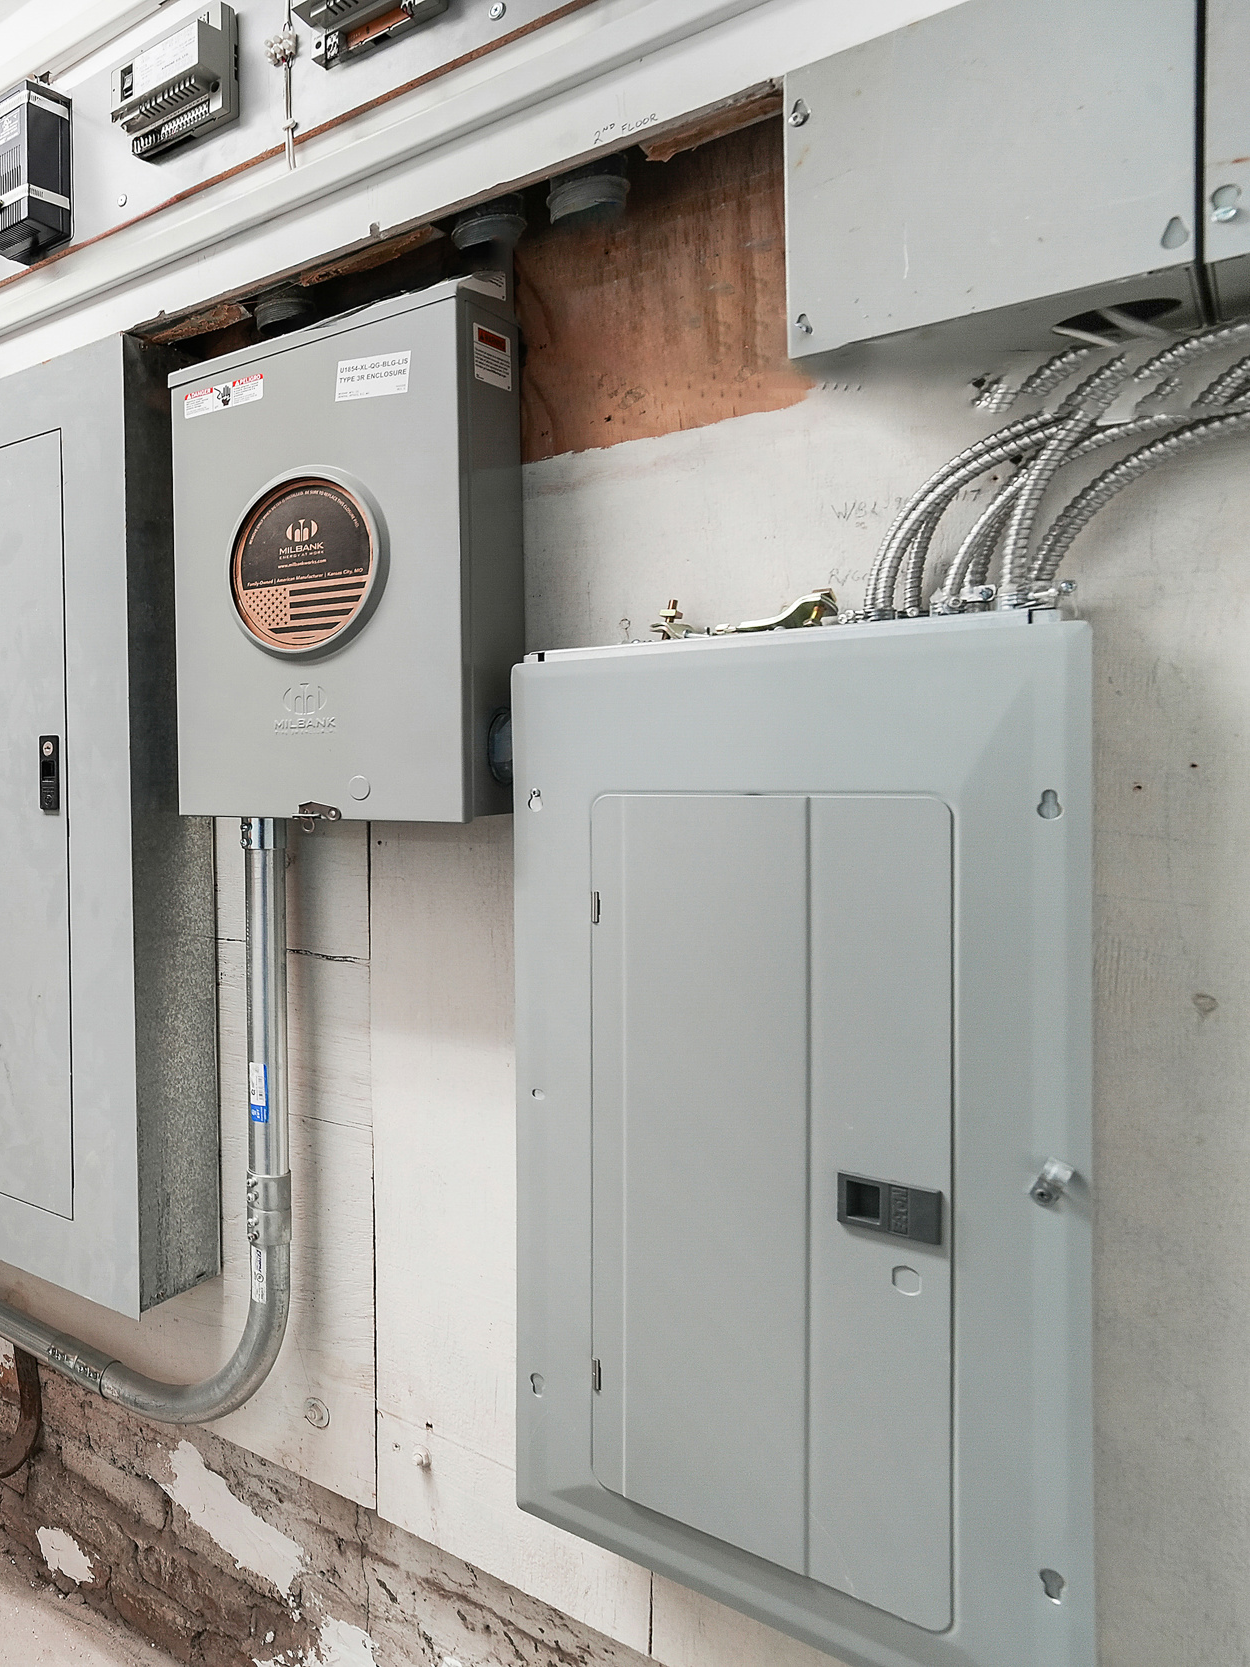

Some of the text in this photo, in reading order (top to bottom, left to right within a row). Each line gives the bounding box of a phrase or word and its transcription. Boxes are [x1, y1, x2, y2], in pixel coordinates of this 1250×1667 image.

[593, 113, 659, 145] 2ND FLOOR
[366, 369, 407, 380] ENCLOSURE
[279, 542, 324, 555] MILBANK
[277, 558, 327, 569] www.milbankworks.com
[247, 579, 273, 587] Family-Owned
[274, 716, 336, 730] MILBANK
